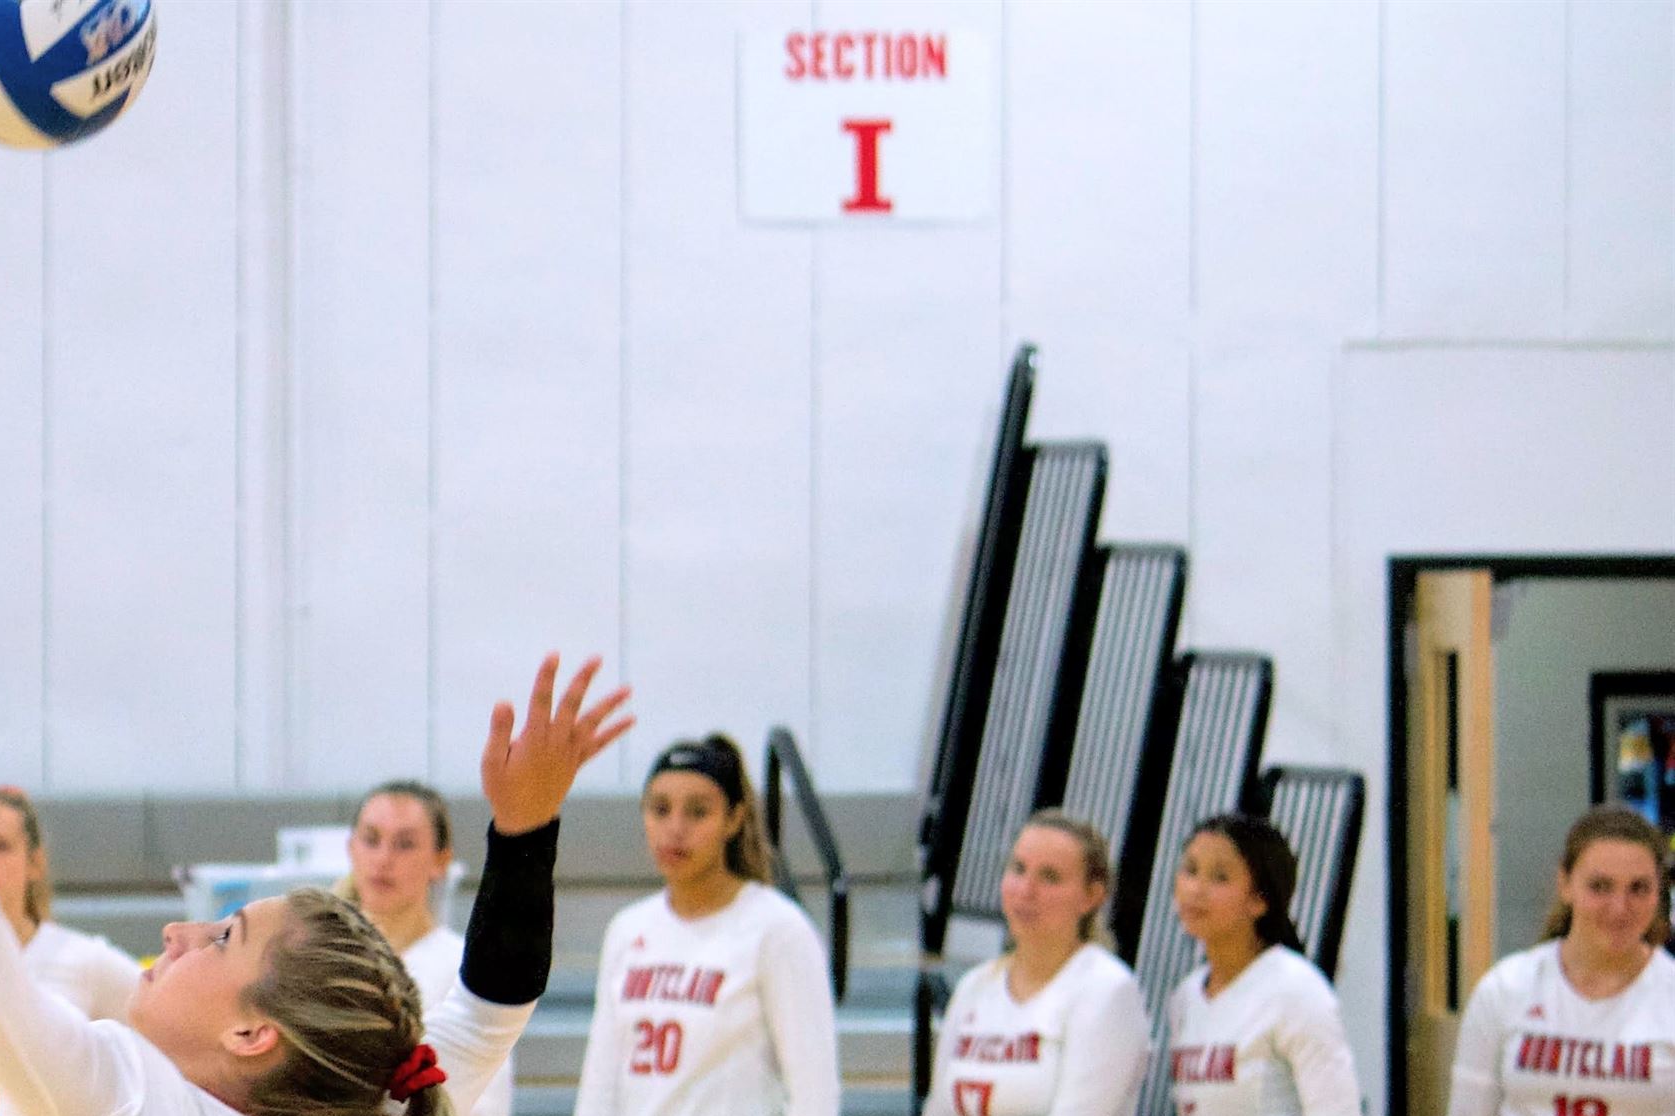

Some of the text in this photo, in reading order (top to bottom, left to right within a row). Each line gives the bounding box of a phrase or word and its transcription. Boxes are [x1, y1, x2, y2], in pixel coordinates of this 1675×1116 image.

[783, 31, 949, 81] SECTION
[840, 117, 894, 214] I
[629, 1018, 684, 1076] 20
